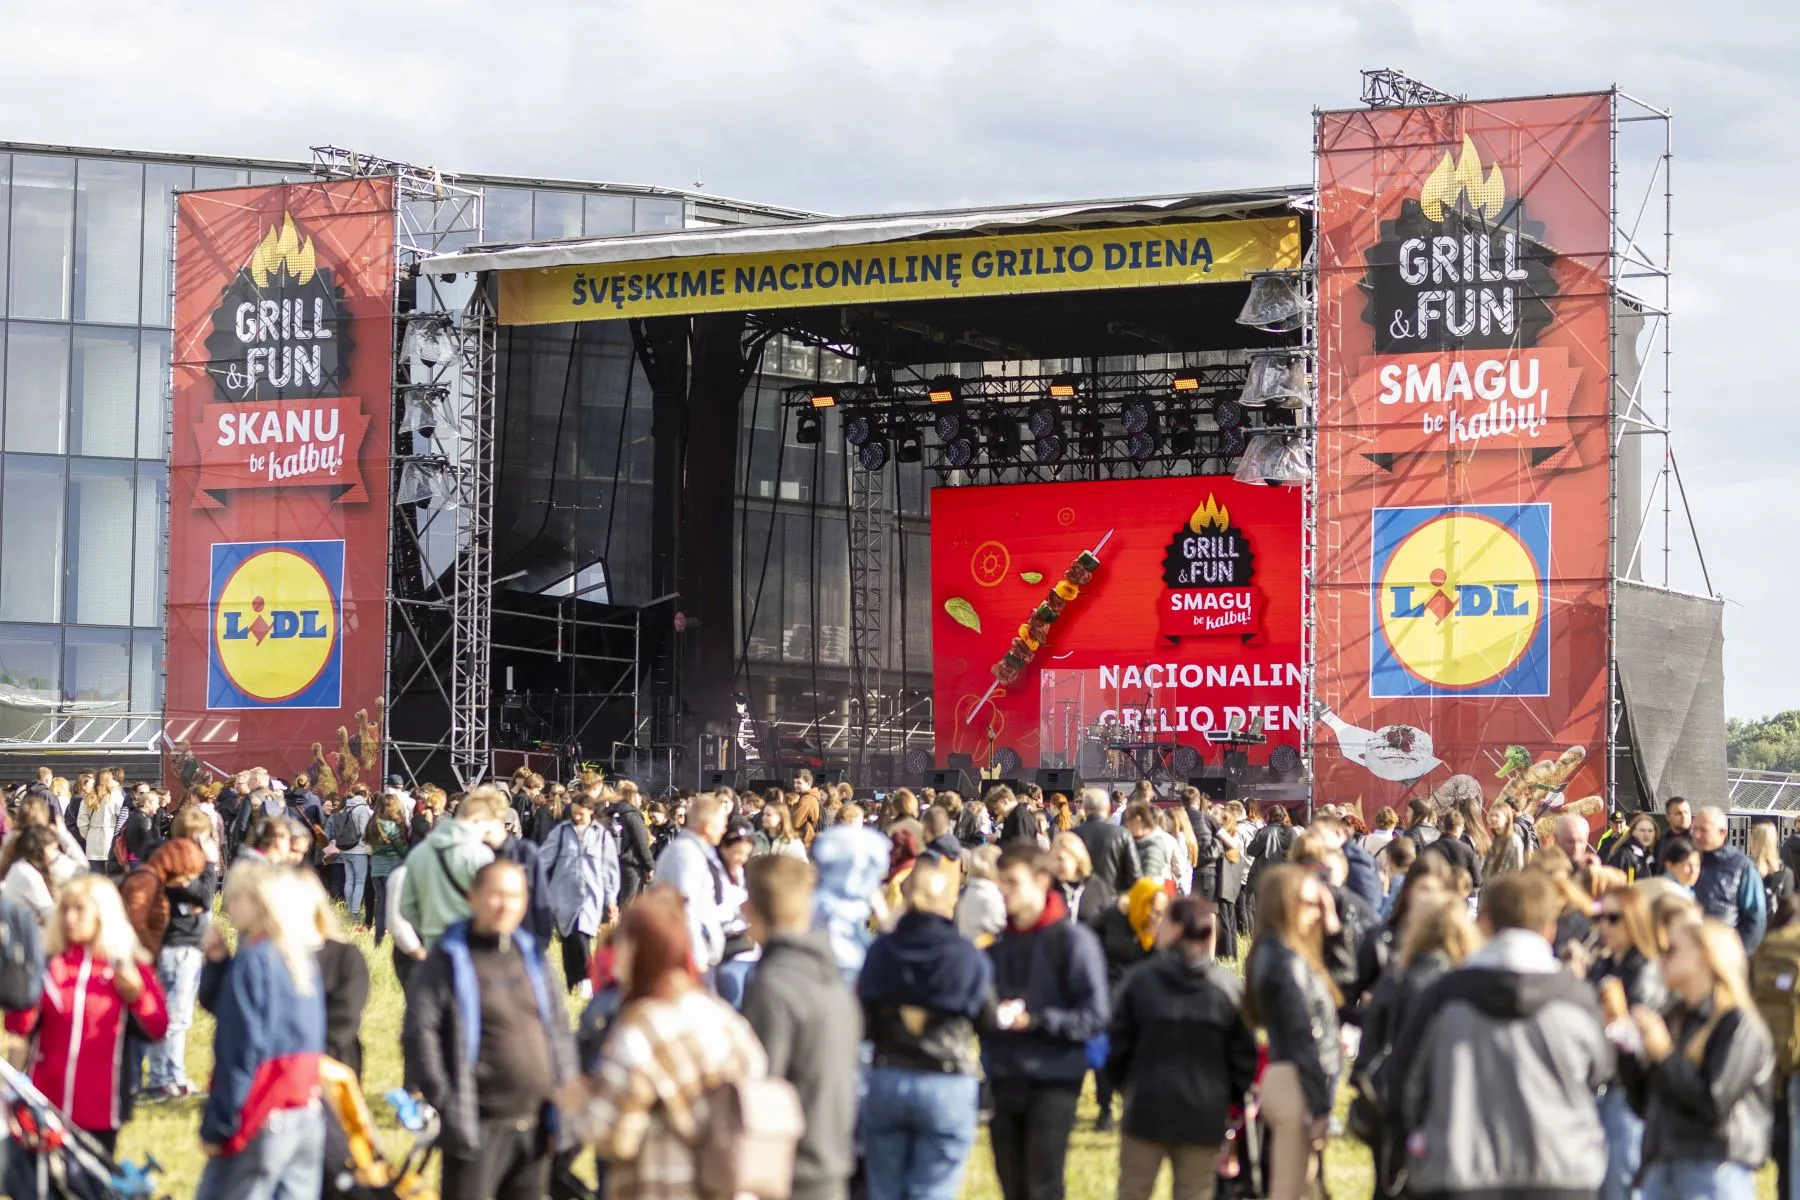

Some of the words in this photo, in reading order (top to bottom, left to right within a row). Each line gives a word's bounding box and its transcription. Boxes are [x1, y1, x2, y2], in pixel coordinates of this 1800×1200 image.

[572, 270, 725, 310] ŠVĘSKIME
[735, 253, 963, 293] NACIONALINĘ
[972, 244, 1093, 279] GRILIO
[1103, 237, 1213, 273] DIENĄ
[1399, 232, 1528, 285] GRILL
[235, 297, 333, 344] GRILL
[1389, 308, 1415, 339] &
[1417, 287, 1514, 339] FUN
[226, 363, 248, 390] &
[246, 344, 321, 390] FUN
[1378, 358, 1540, 406] SMAGU
[217, 408, 340, 447] SKANU
[1423, 412, 1444, 435] be
[1449, 388, 1548, 445] kalbų!
[249, 453, 265, 474] be
[267, 433, 346, 482] kalbų!
[1183, 535, 1240, 559] GRILL
[1178, 568, 1189, 584] &
[1190, 560, 1234, 584] FUN
[1171, 592, 1251, 611] SMAGU
[1193, 615, 1204, 626] be
